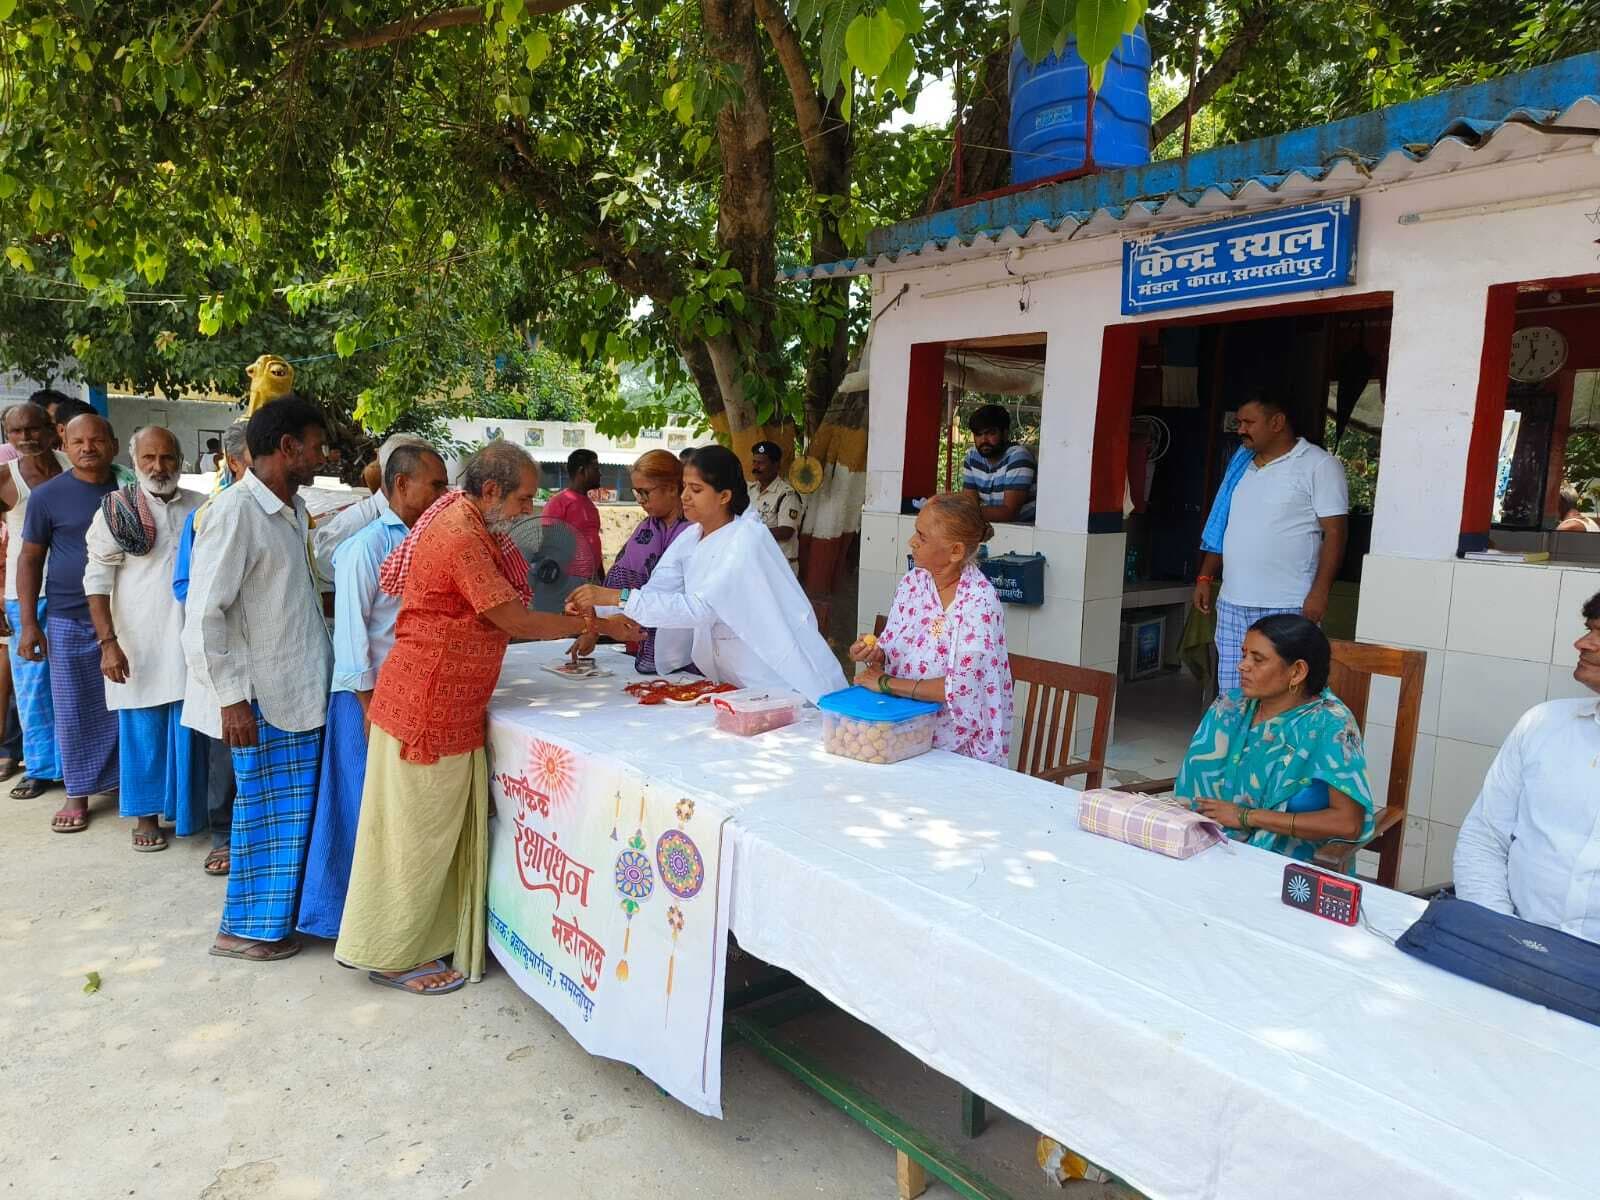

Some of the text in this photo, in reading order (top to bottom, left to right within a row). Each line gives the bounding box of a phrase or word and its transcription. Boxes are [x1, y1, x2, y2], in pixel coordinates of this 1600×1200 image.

[1136, 241, 1220, 277] केन्द्र
[1137, 280, 1180, 296] मंडल
[1232, 257, 1324, 281] समस्तीपुर
